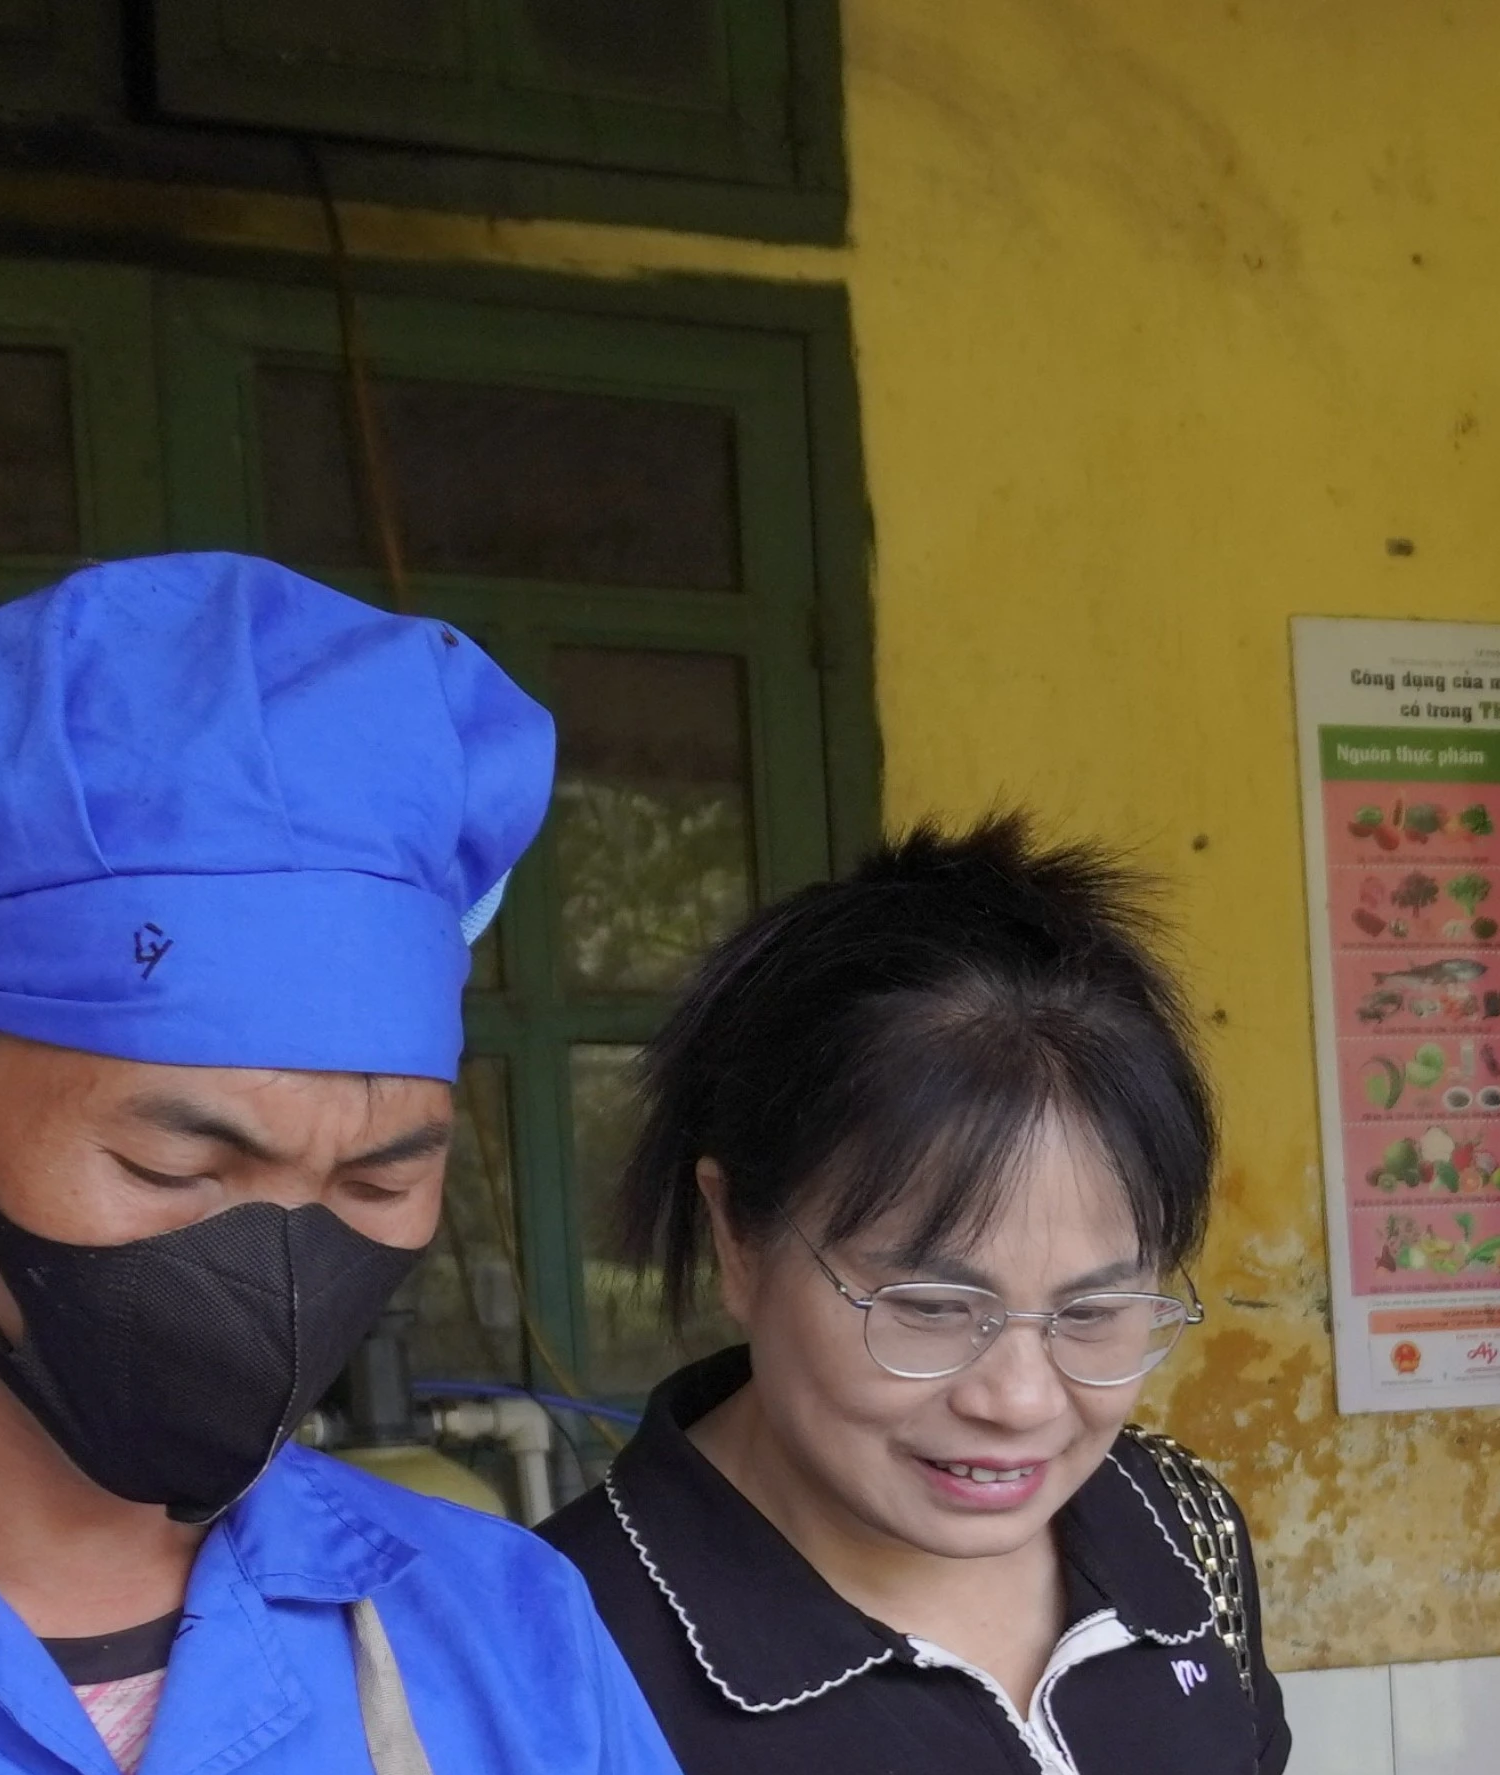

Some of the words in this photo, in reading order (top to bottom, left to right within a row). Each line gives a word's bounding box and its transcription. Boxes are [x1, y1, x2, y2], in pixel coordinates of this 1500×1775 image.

[1350, 668, 1394, 691] Công
[1402, 669, 1445, 692] dụng
[1453, 668, 1483, 690] của
[1400, 701, 1421, 718] có
[1426, 702, 1472, 723] trong
